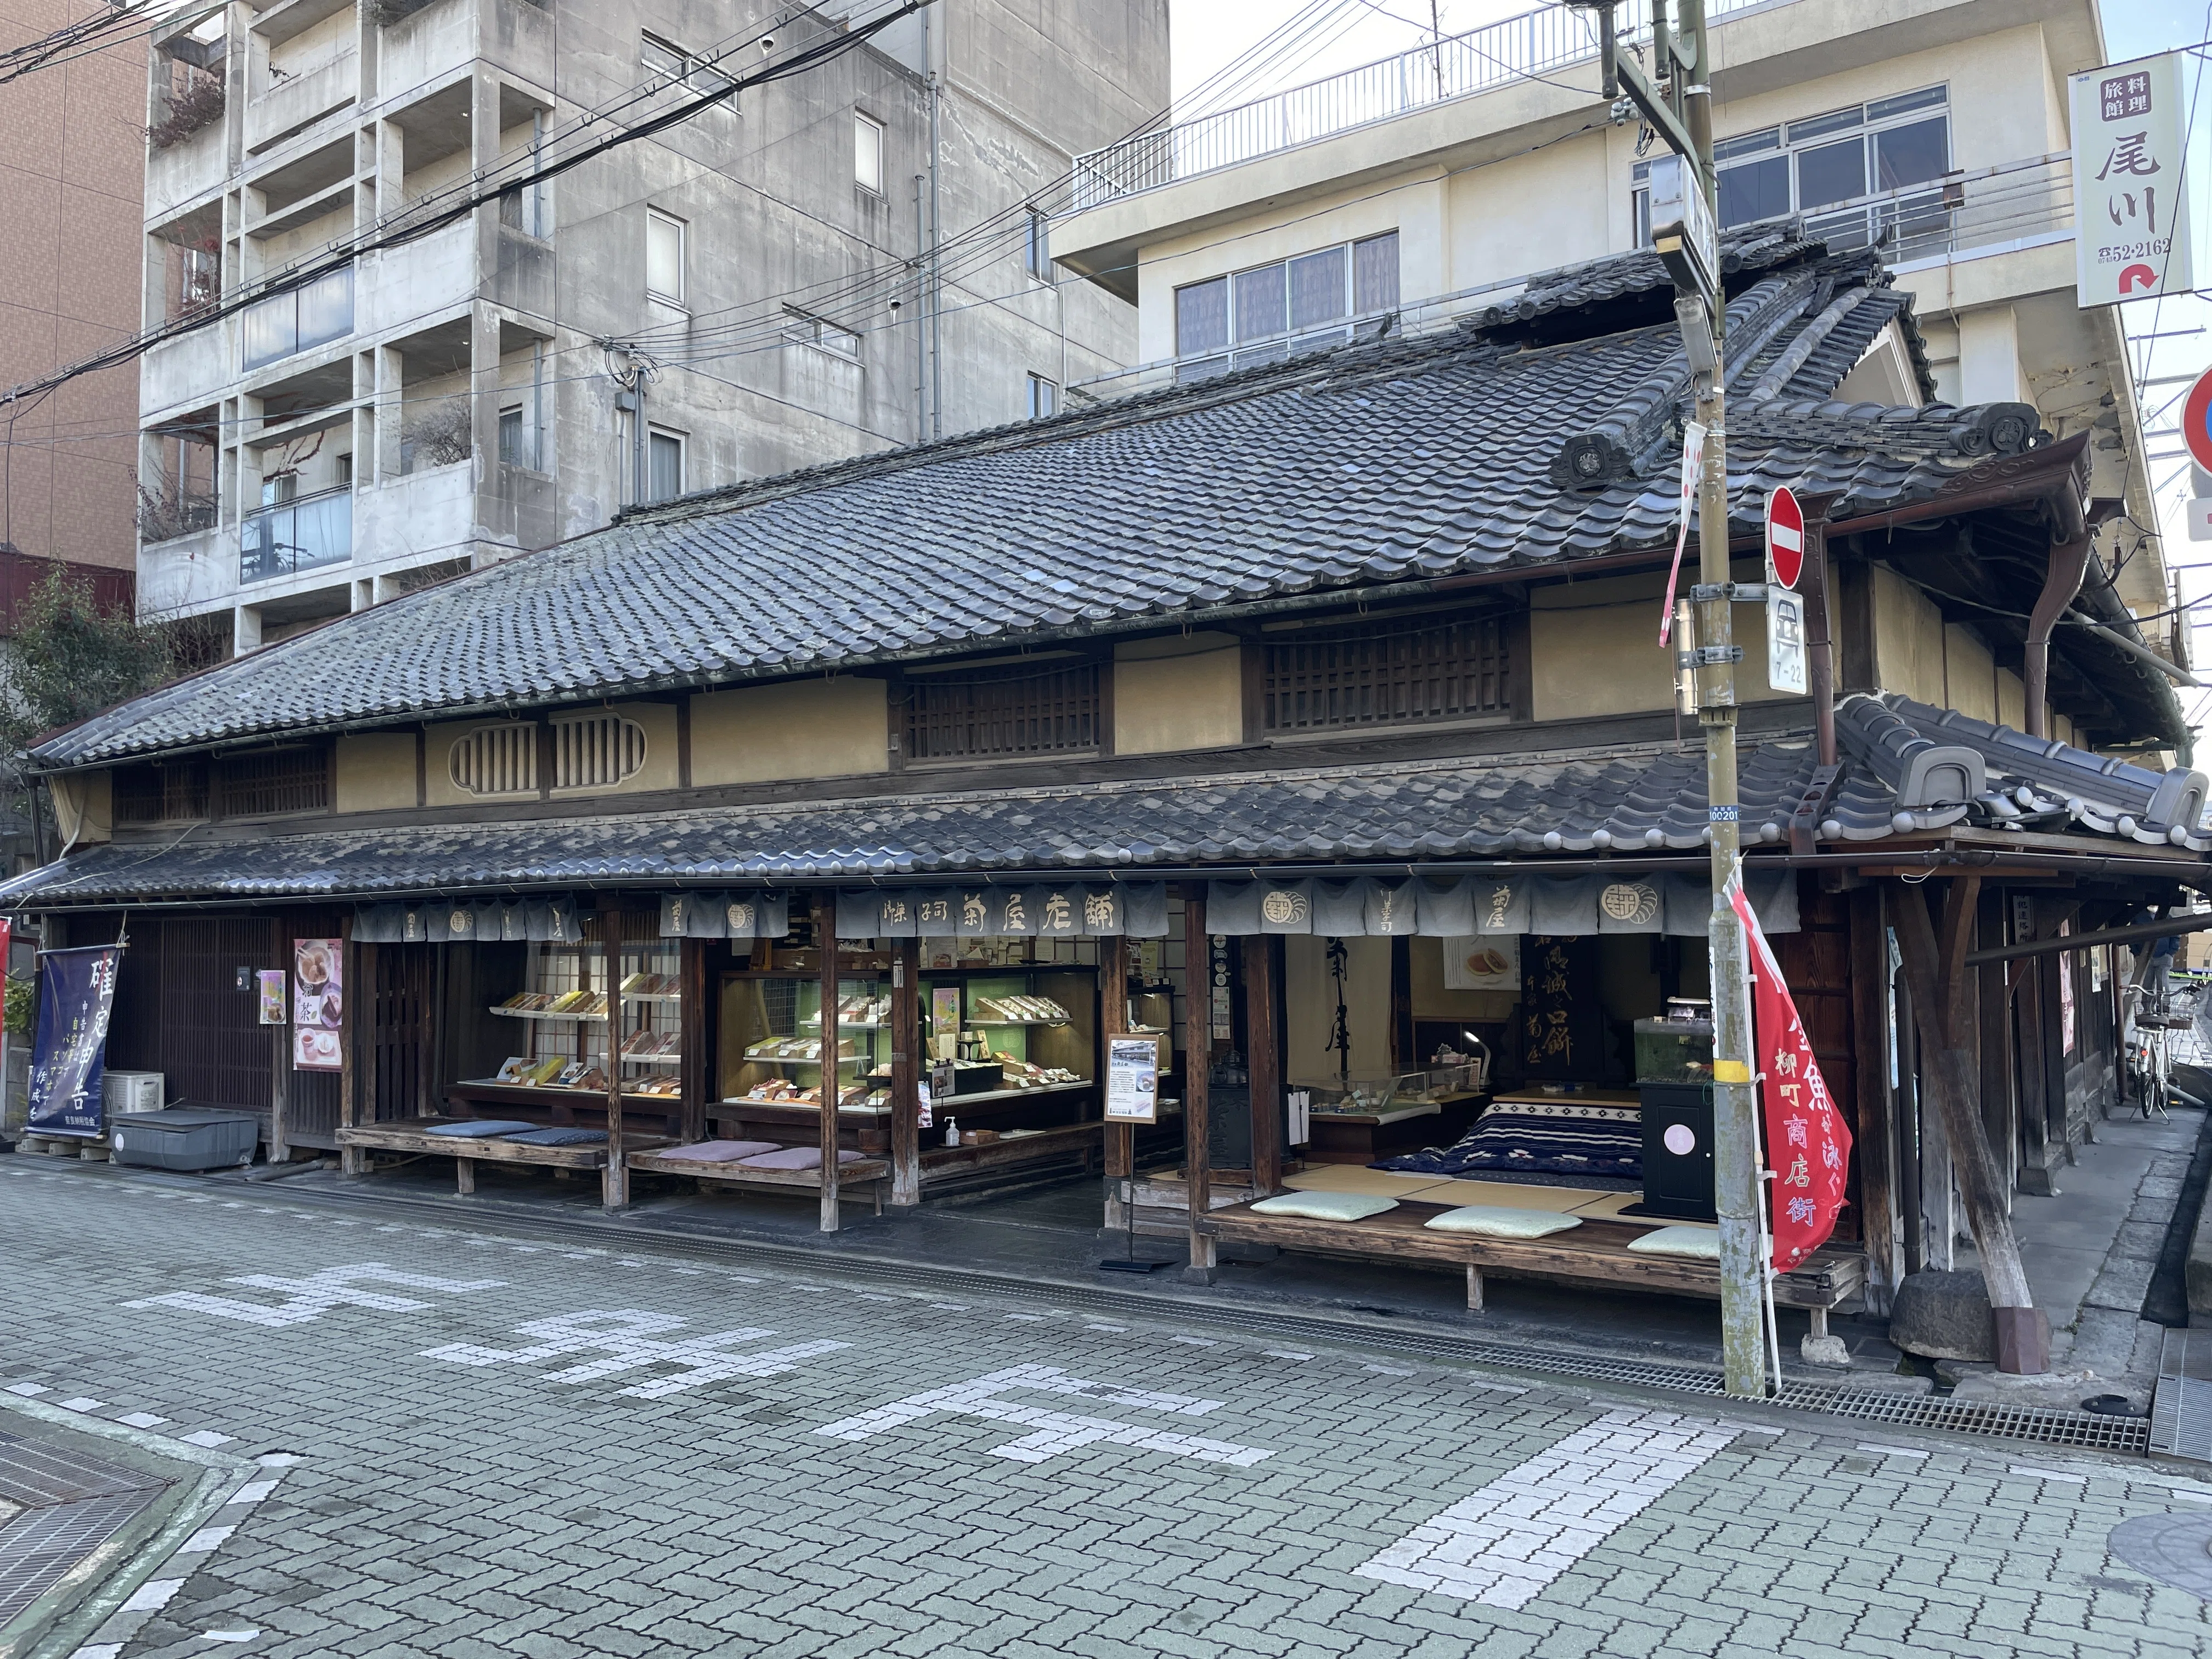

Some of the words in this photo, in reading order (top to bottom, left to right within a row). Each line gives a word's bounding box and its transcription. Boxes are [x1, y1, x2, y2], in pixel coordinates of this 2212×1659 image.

[2104, 82, 2124, 118] 旅館
[2128, 76, 2147, 112] 料理
[2095, 131, 2161, 235] 尾川
[1486, 884, 1512, 928] 菊屋
[72, 958, 114, 1110] 確定申告
[1775, 1047, 1816, 1227] 柳町商店街
